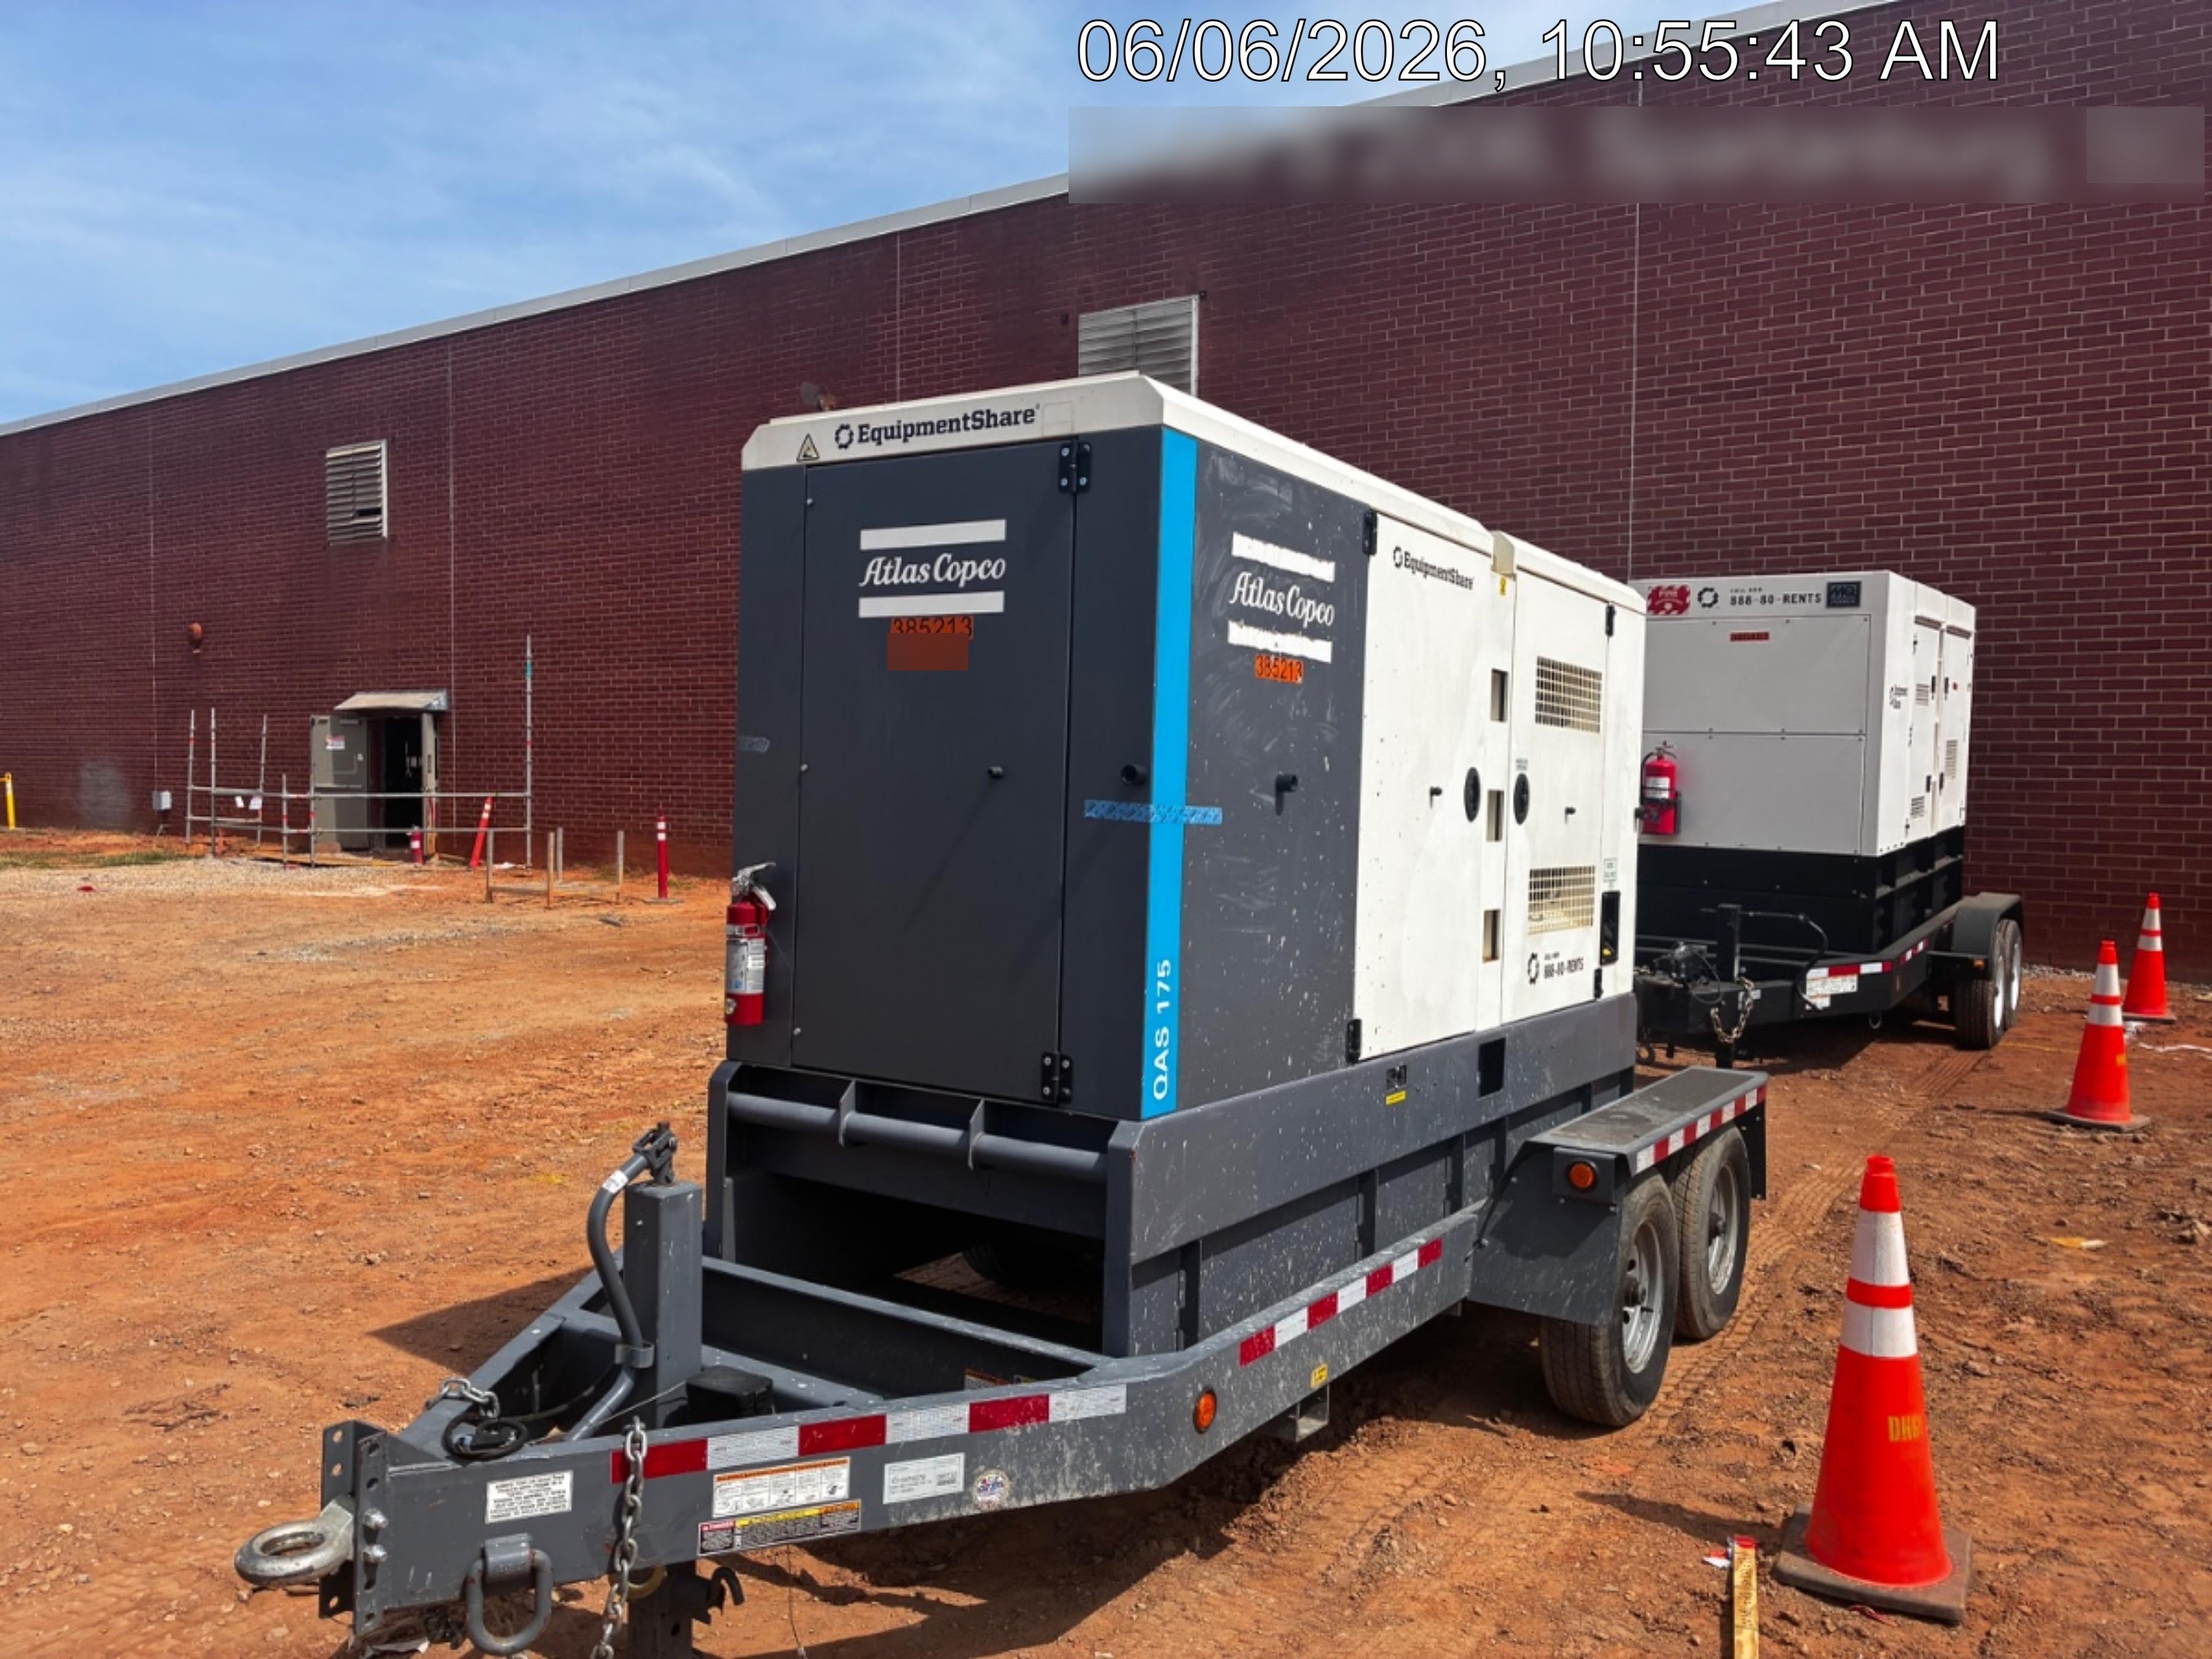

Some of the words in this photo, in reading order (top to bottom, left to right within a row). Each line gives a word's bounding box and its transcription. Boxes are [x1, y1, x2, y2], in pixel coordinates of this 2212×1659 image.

[858, 408, 1036, 446] EquipmentShare
[858, 556, 931, 587] Atlas
[933, 553, 1006, 588] Copco
[1229, 571, 1285, 615] Atlas
[1286, 584, 1335, 629] Copco
[1730, 593, 1822, 606] 888-80-RENTS
[1256, 655, 1303, 683] 385213
[1156, 959, 1171, 1014] 175
[1153, 1026, 1170, 1100] QAS
